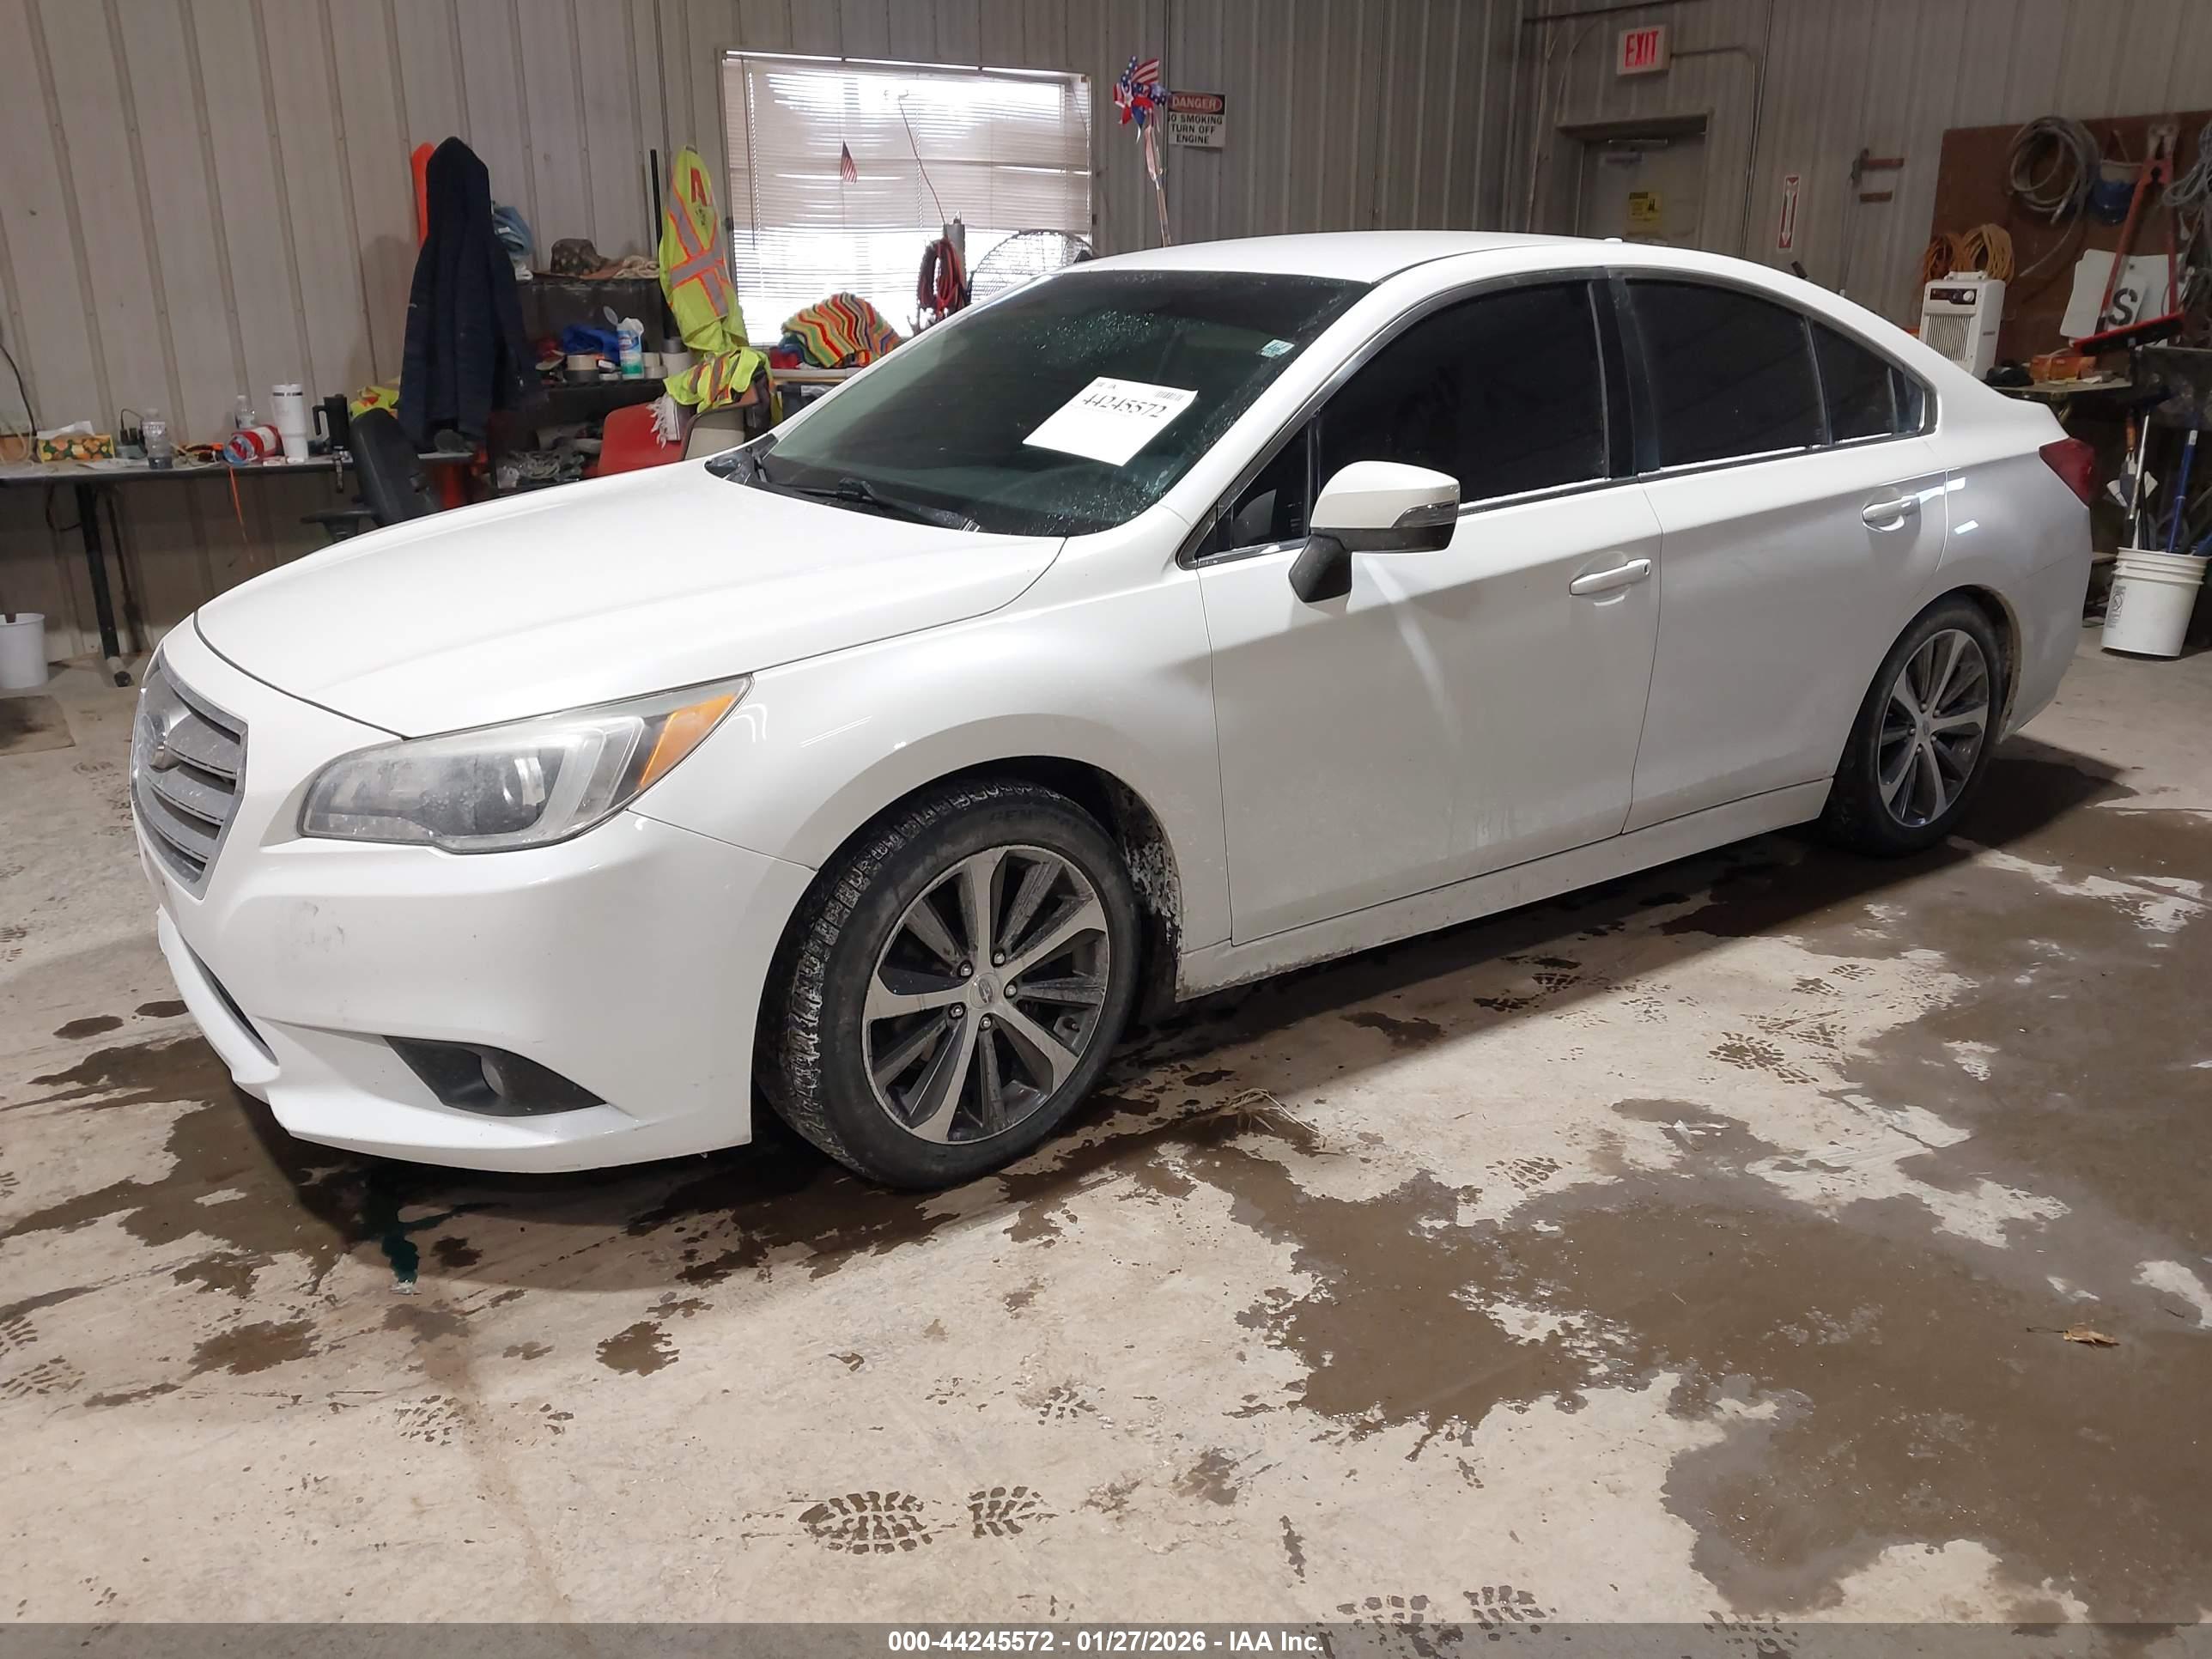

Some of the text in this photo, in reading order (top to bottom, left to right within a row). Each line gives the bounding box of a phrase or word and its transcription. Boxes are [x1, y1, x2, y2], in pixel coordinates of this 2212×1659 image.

[1625, 31, 1659, 67] EXIT
[1172, 95, 1217, 110] DANGER
[1181, 114, 1223, 125] SMOKING
[1171, 124, 1215, 135] TURN OFF
[1176, 134, 1209, 144] ENGINE
[2108, 288, 2138, 325] S
[1082, 393, 1168, 418] 44245572
